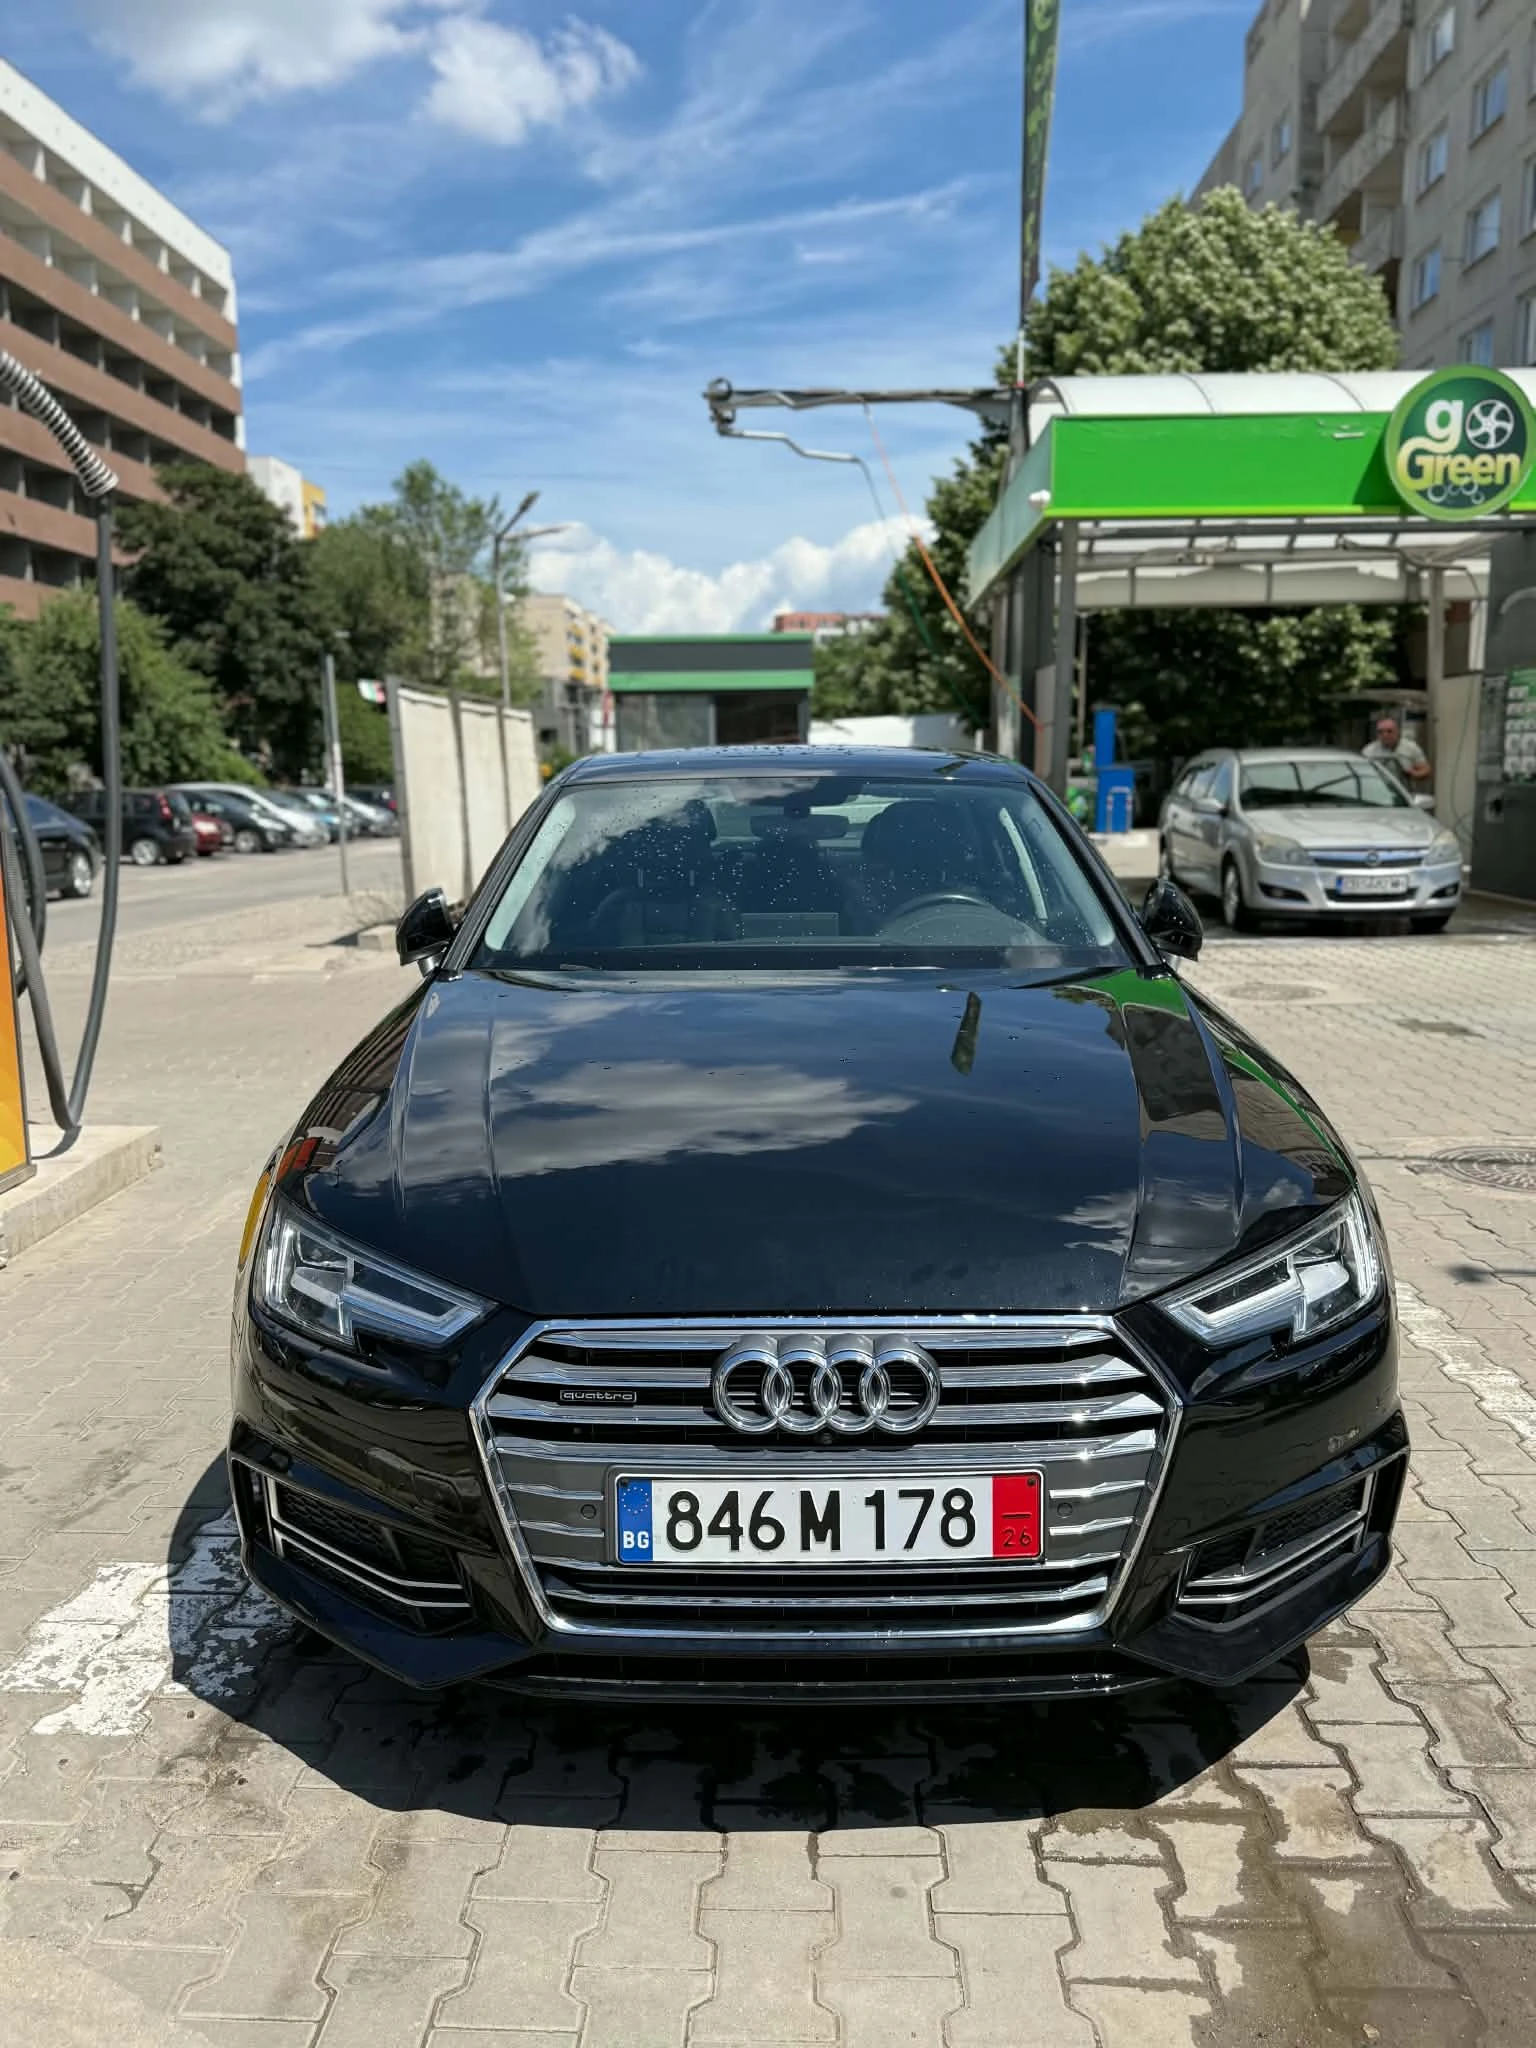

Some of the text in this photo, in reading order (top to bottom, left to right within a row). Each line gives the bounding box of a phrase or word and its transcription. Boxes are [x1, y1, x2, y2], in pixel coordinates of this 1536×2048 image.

[1397, 440, 1520, 491] Green
[563, 1391, 633, 1400] quattro
[666, 1487, 976, 1552] 846 M 178
[623, 1531, 650, 1549] BG
[1002, 1526, 1032, 1548] 26
